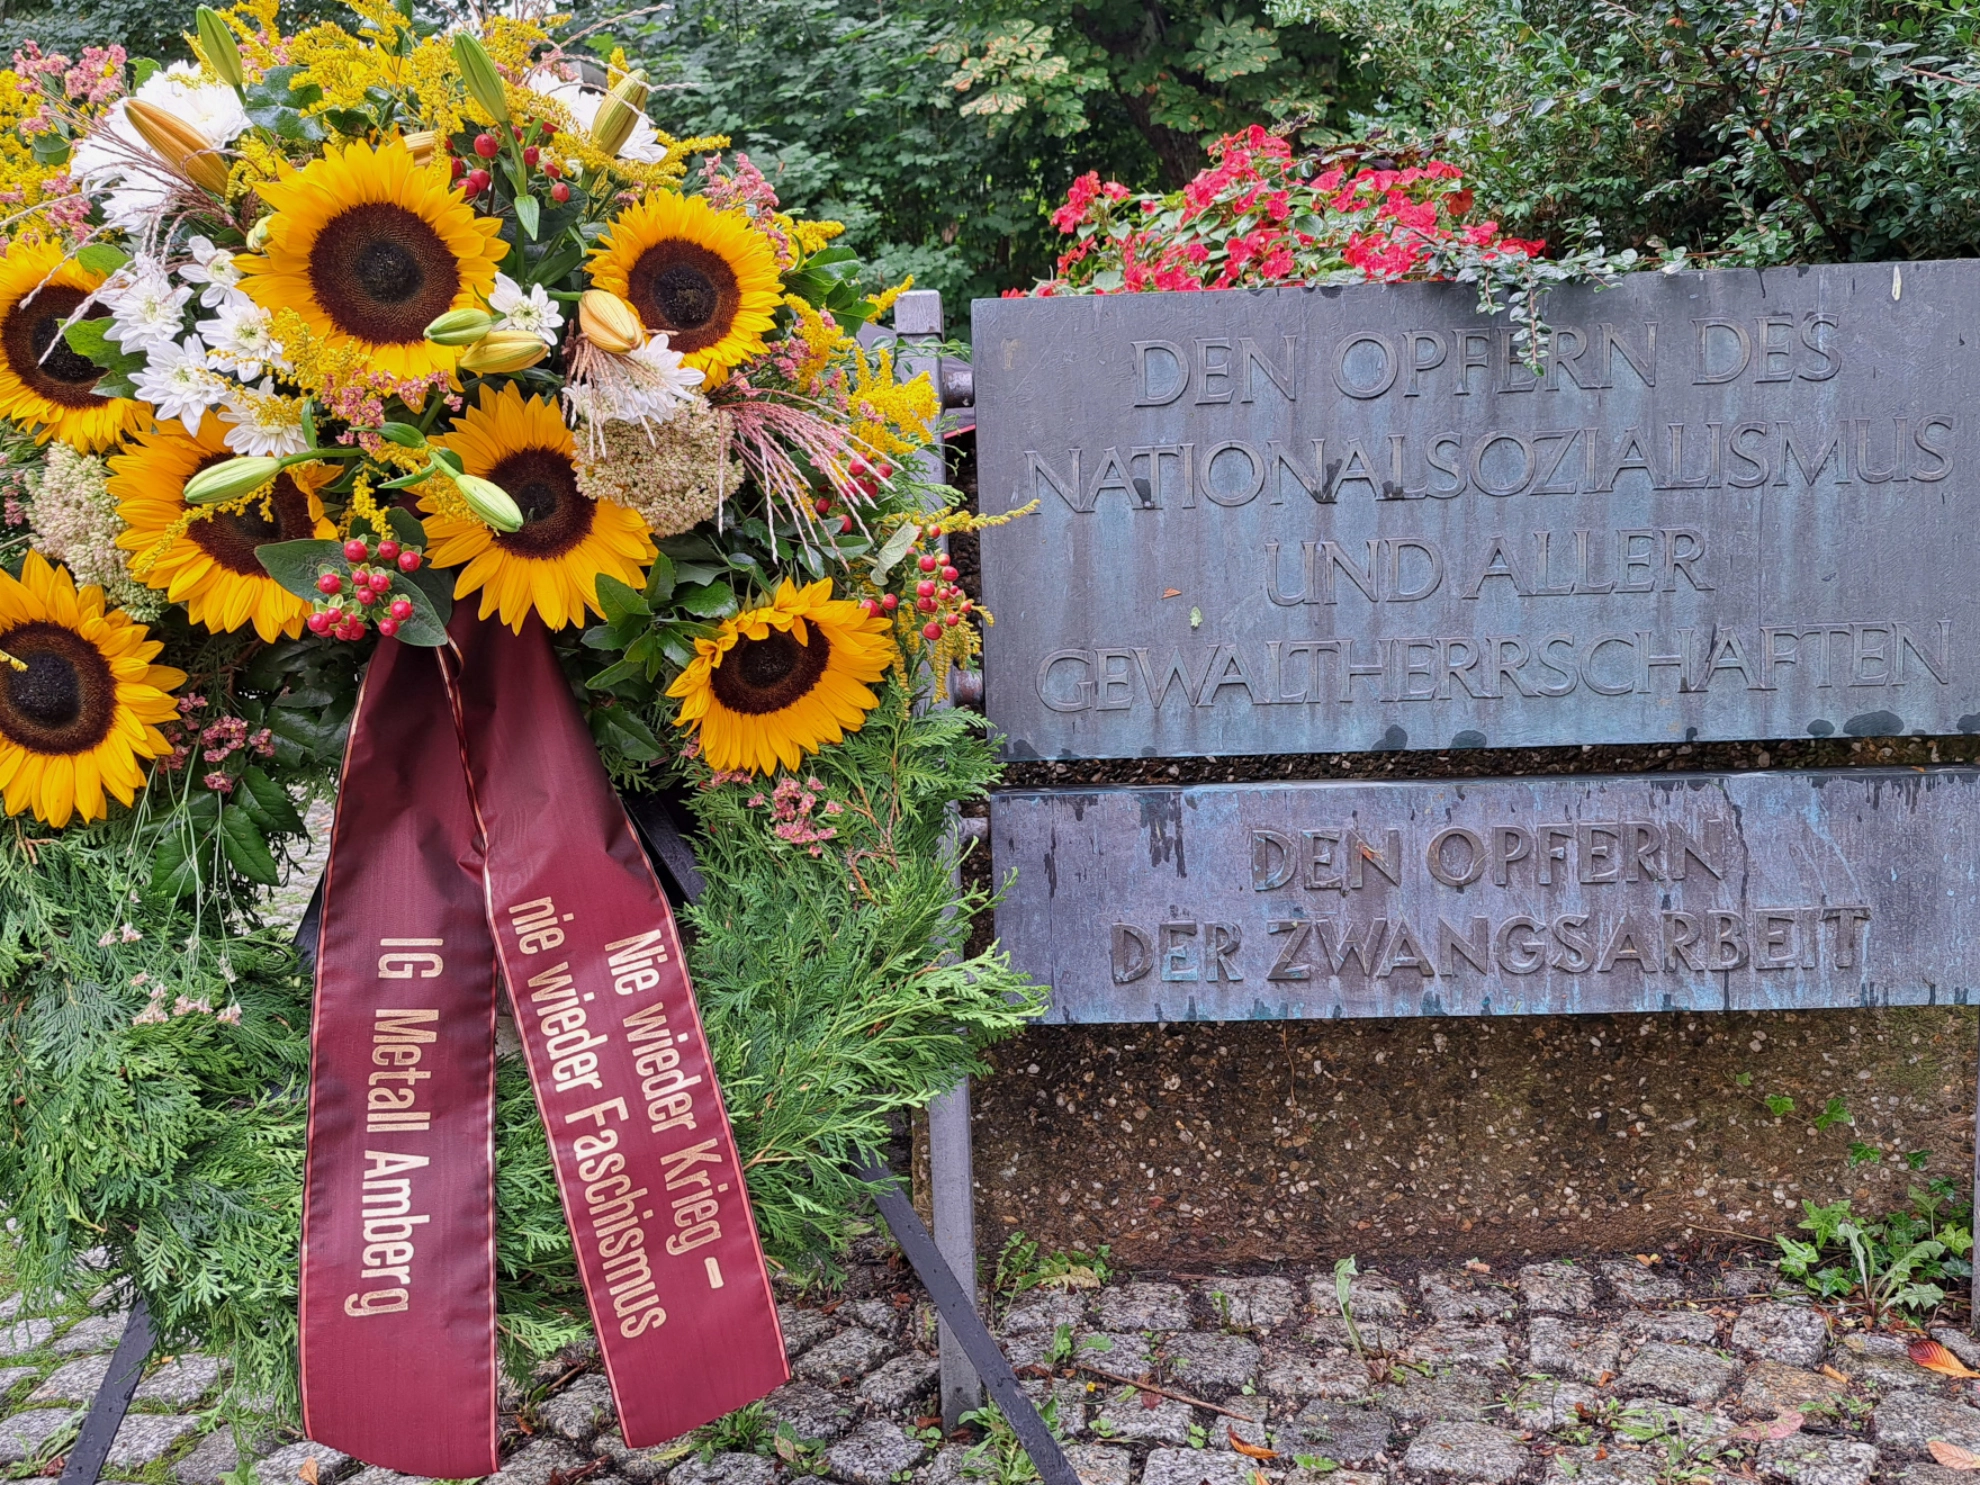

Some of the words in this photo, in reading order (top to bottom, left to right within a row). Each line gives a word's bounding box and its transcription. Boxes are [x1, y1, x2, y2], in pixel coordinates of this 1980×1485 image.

[1130, 334, 1298, 407] DEN
[1331, 321, 1658, 400] OPFERN
[1691, 312, 1842, 386] DES
[1024, 414, 1955, 516] NATIONALSOZIALISMUS
[1265, 537, 1443, 607] UND
[1462, 528, 1716, 600] ALLER
[1035, 619, 1953, 713] GEWALTHERRSCHAFTEN
[1251, 826, 1400, 892] DEN
[1426, 818, 1723, 887] OPFERN
[377, 937, 444, 979] IG
[508, 896, 575, 955] nie
[604, 929, 668, 996] Nie
[1110, 919, 1243, 985] DER
[1266, 907, 1872, 982] ZWANGSARBEIT
[366, 1009, 440, 1133] Metall
[527, 961, 609, 1093] wieder
[622, 1002, 703, 1134] wieder
[344, 1150, 430, 1317] Amberg
[565, 1096, 668, 1340] Faschismus
[660, 1138, 728, 1256] Krieg
